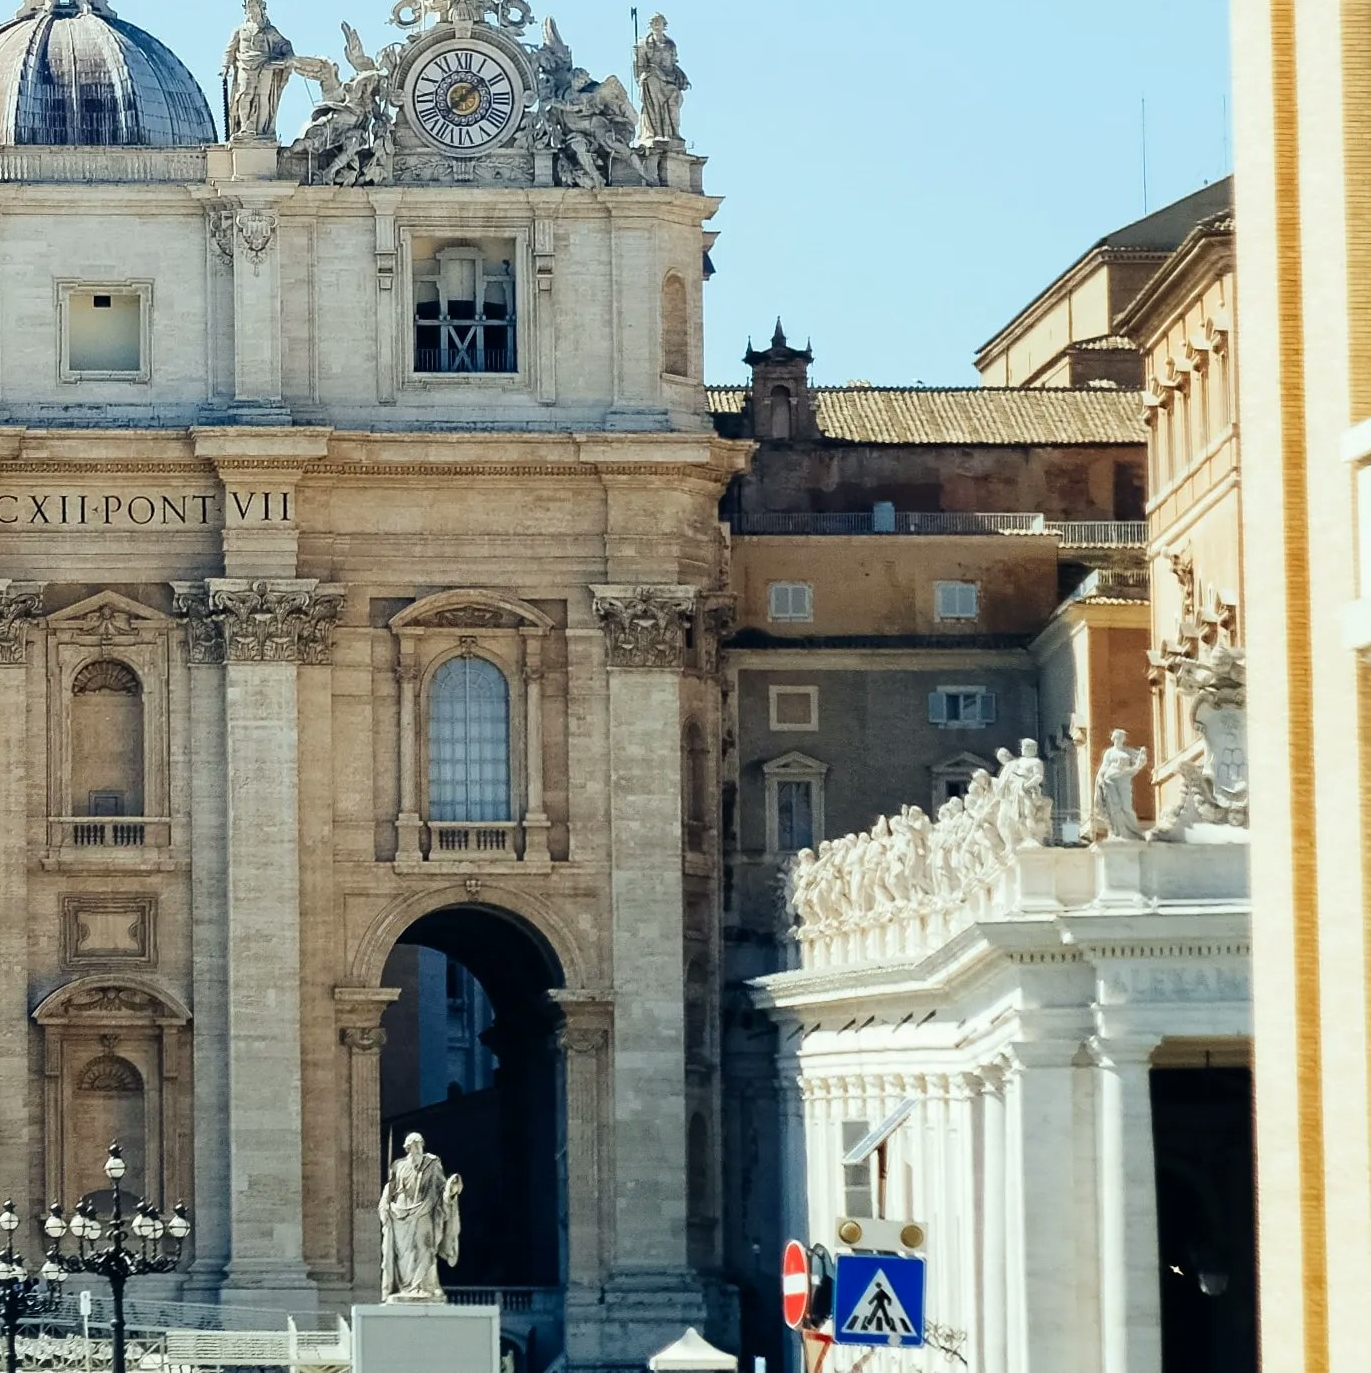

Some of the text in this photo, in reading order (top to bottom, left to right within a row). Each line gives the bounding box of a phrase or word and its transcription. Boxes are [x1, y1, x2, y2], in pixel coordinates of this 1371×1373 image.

[450, 53, 472, 69] XII
[477, 59, 487, 73] I
[488, 72, 504, 86] II
[493, 93, 509, 105] III
[479, 126, 491, 141] V
[102, 493, 216, 525] PONT
[228, 491, 291, 521] VII
